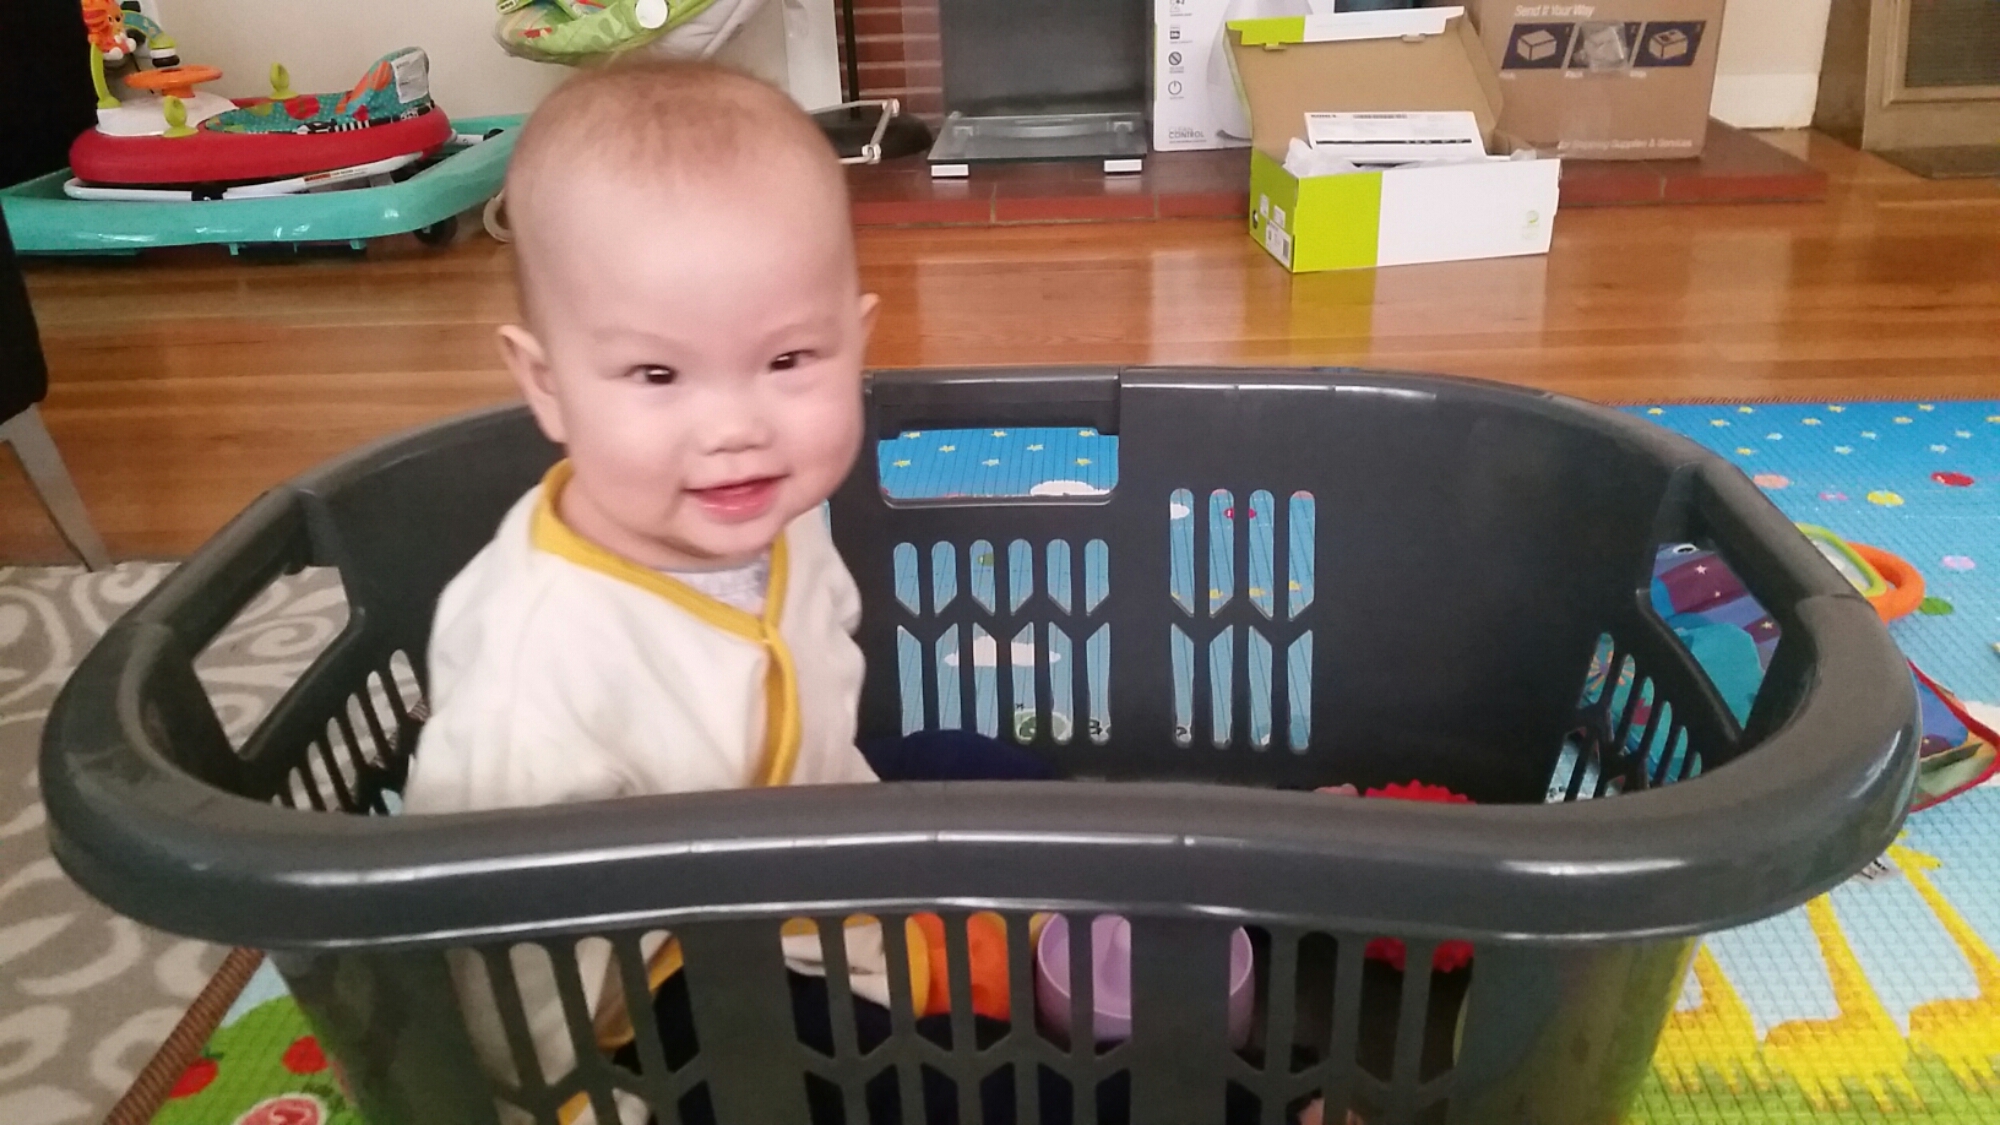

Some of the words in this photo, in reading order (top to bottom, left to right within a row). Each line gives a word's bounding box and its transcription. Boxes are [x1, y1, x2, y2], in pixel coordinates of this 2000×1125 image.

[1514, 5, 1541, 17] Send
[1541, 5, 1549, 16] It
[1550, 5, 1571, 16] Your
[1573, 5, 1595, 18] Way
[1168, 131, 1204, 139] CONTROL
[1656, 137, 1692, 148] Services
